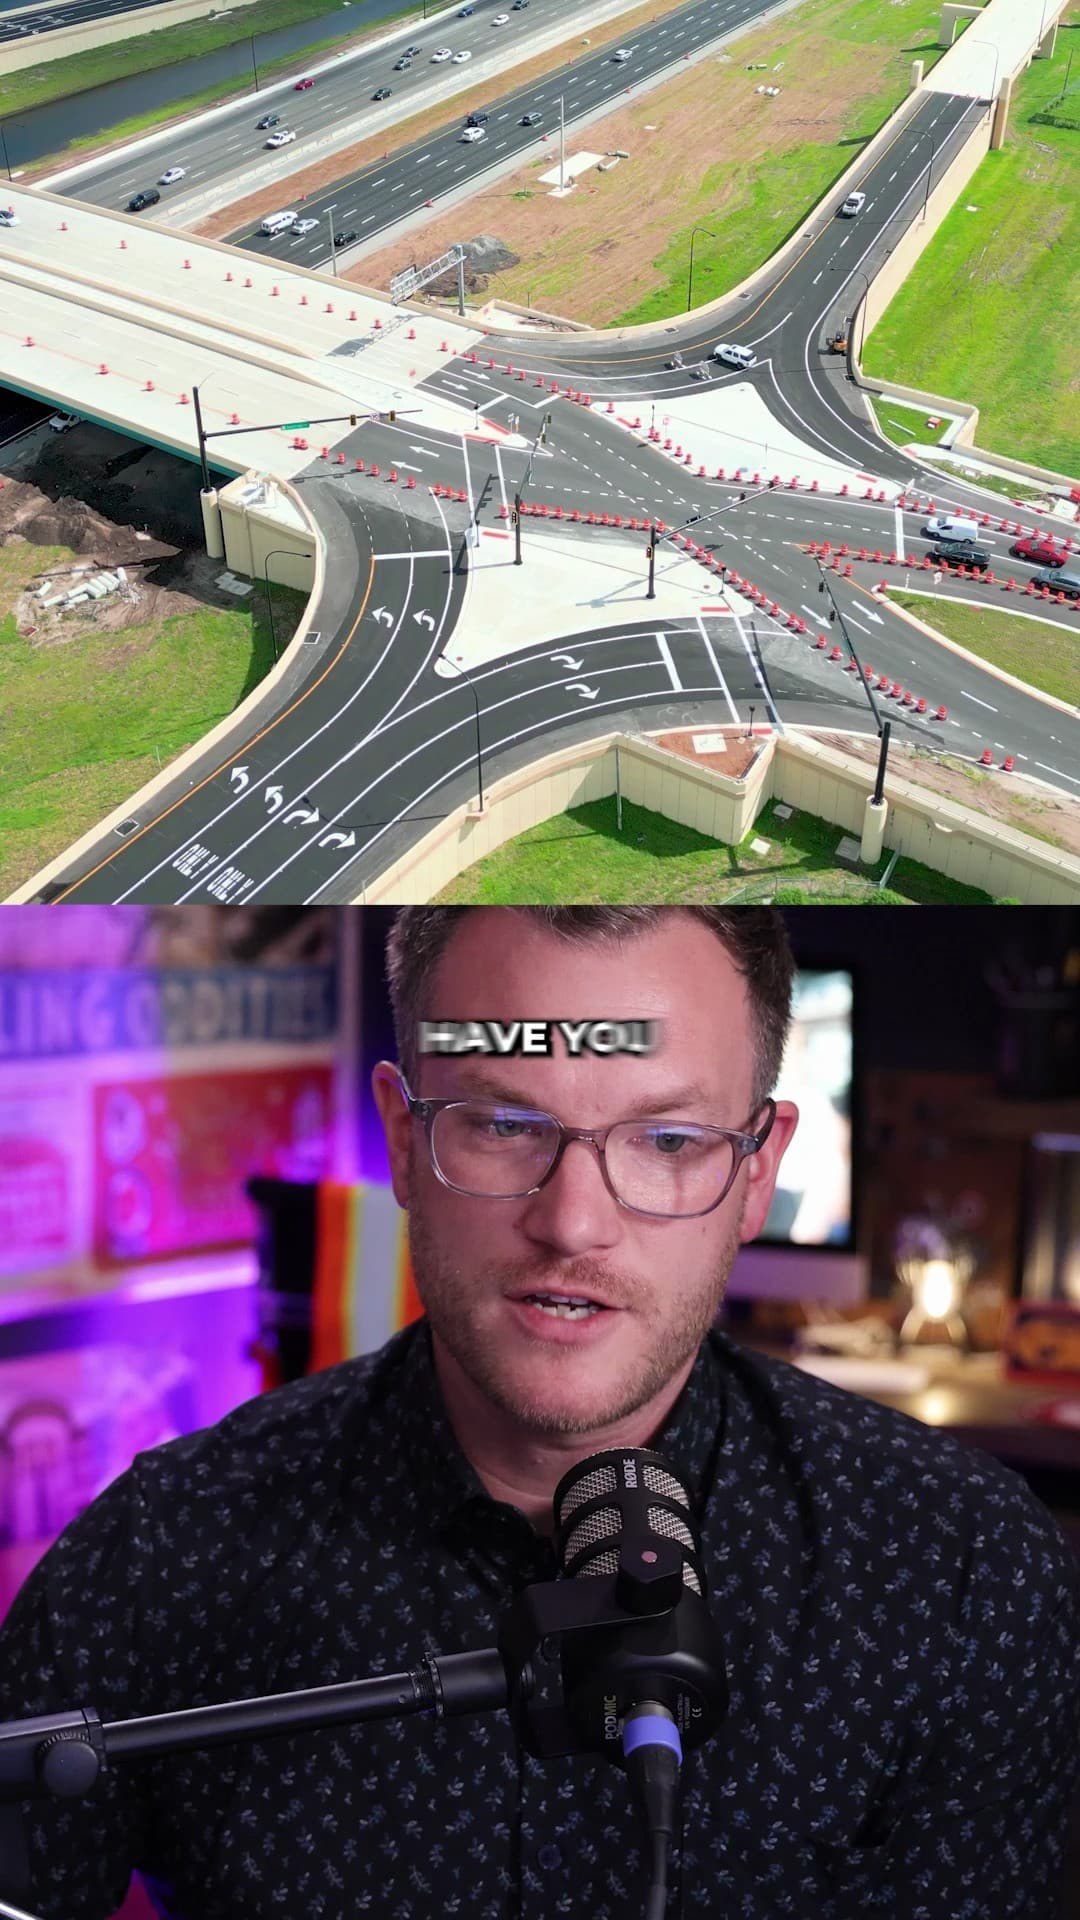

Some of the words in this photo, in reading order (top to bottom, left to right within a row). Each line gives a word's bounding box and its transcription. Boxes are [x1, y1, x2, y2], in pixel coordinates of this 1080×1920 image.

[172, 844, 219, 879] ONLY
[206, 866, 255, 904] ONLY
[623, 1458, 638, 1489] RØDE
[603, 1695, 617, 1741] PODMIC
